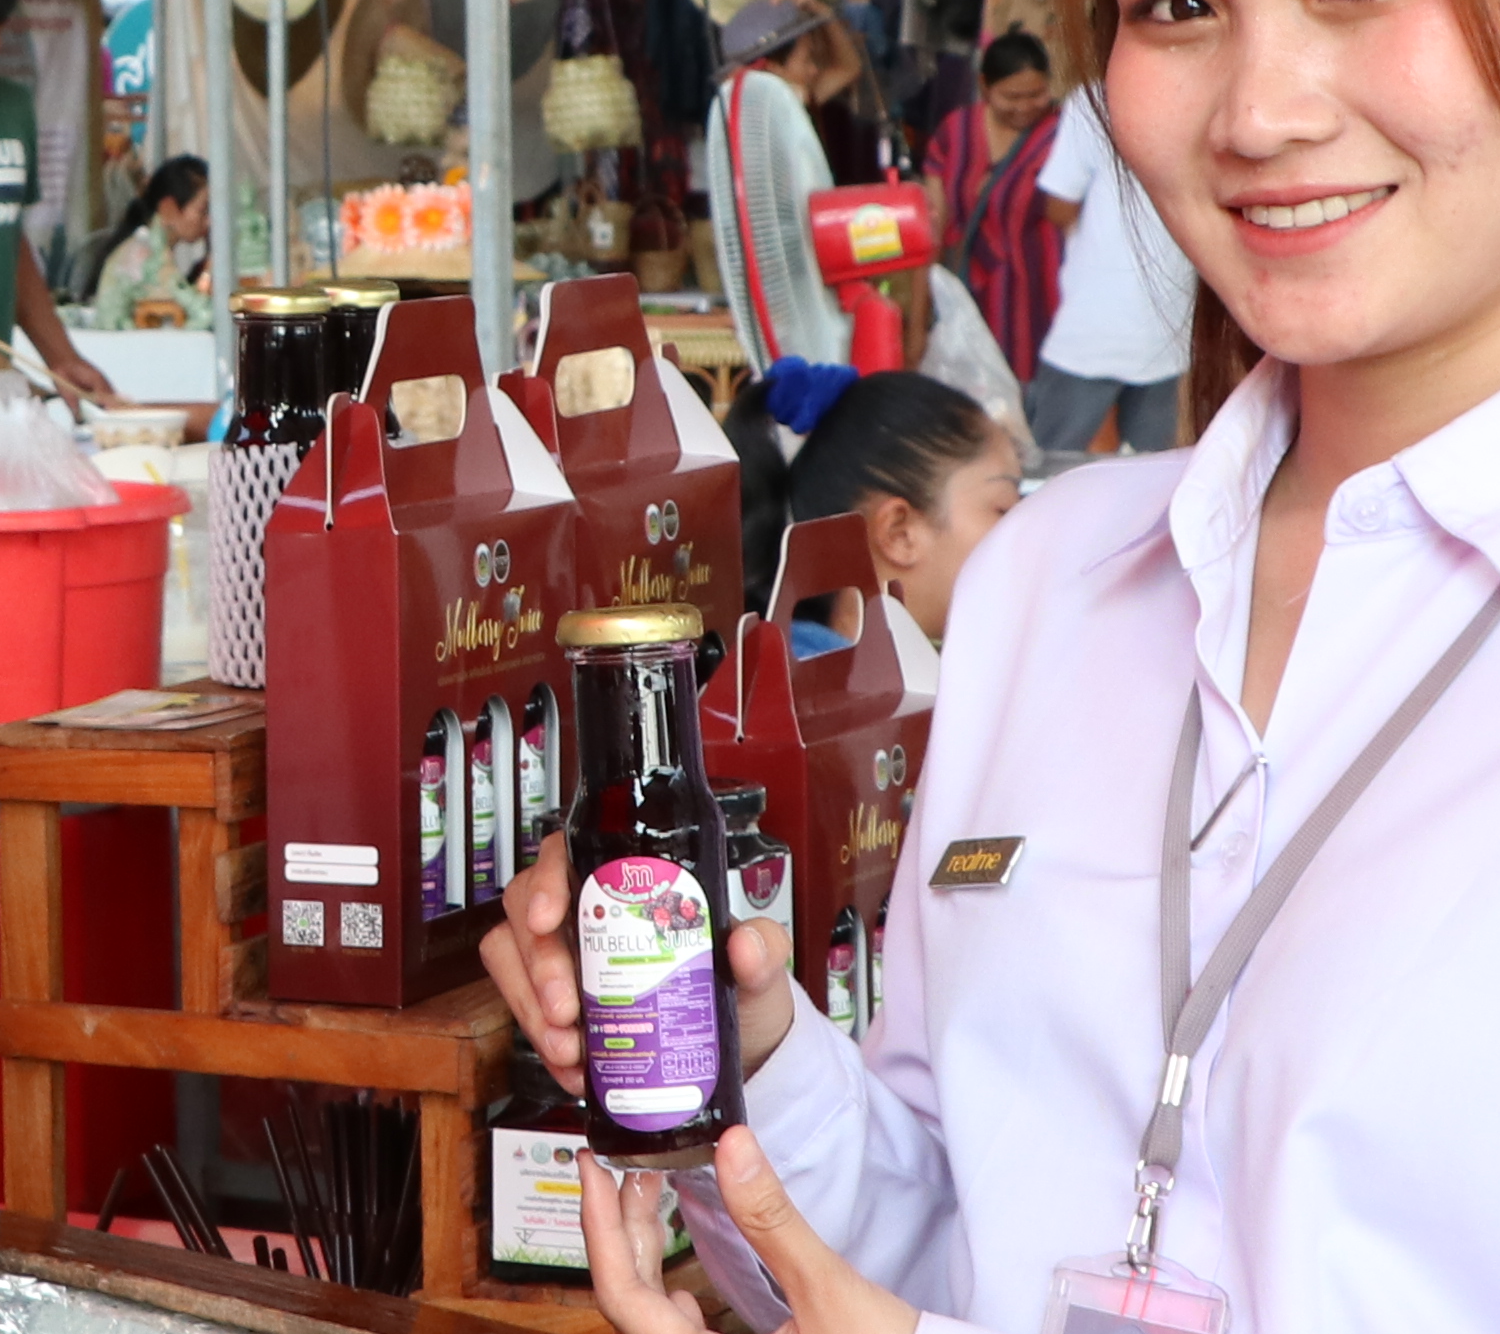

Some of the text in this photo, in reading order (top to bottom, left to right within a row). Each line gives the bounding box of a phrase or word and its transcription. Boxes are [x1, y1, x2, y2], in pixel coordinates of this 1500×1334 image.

[435, 596, 505, 662] Mulberry
[584, 929, 706, 953] MULBELLY JUICE
